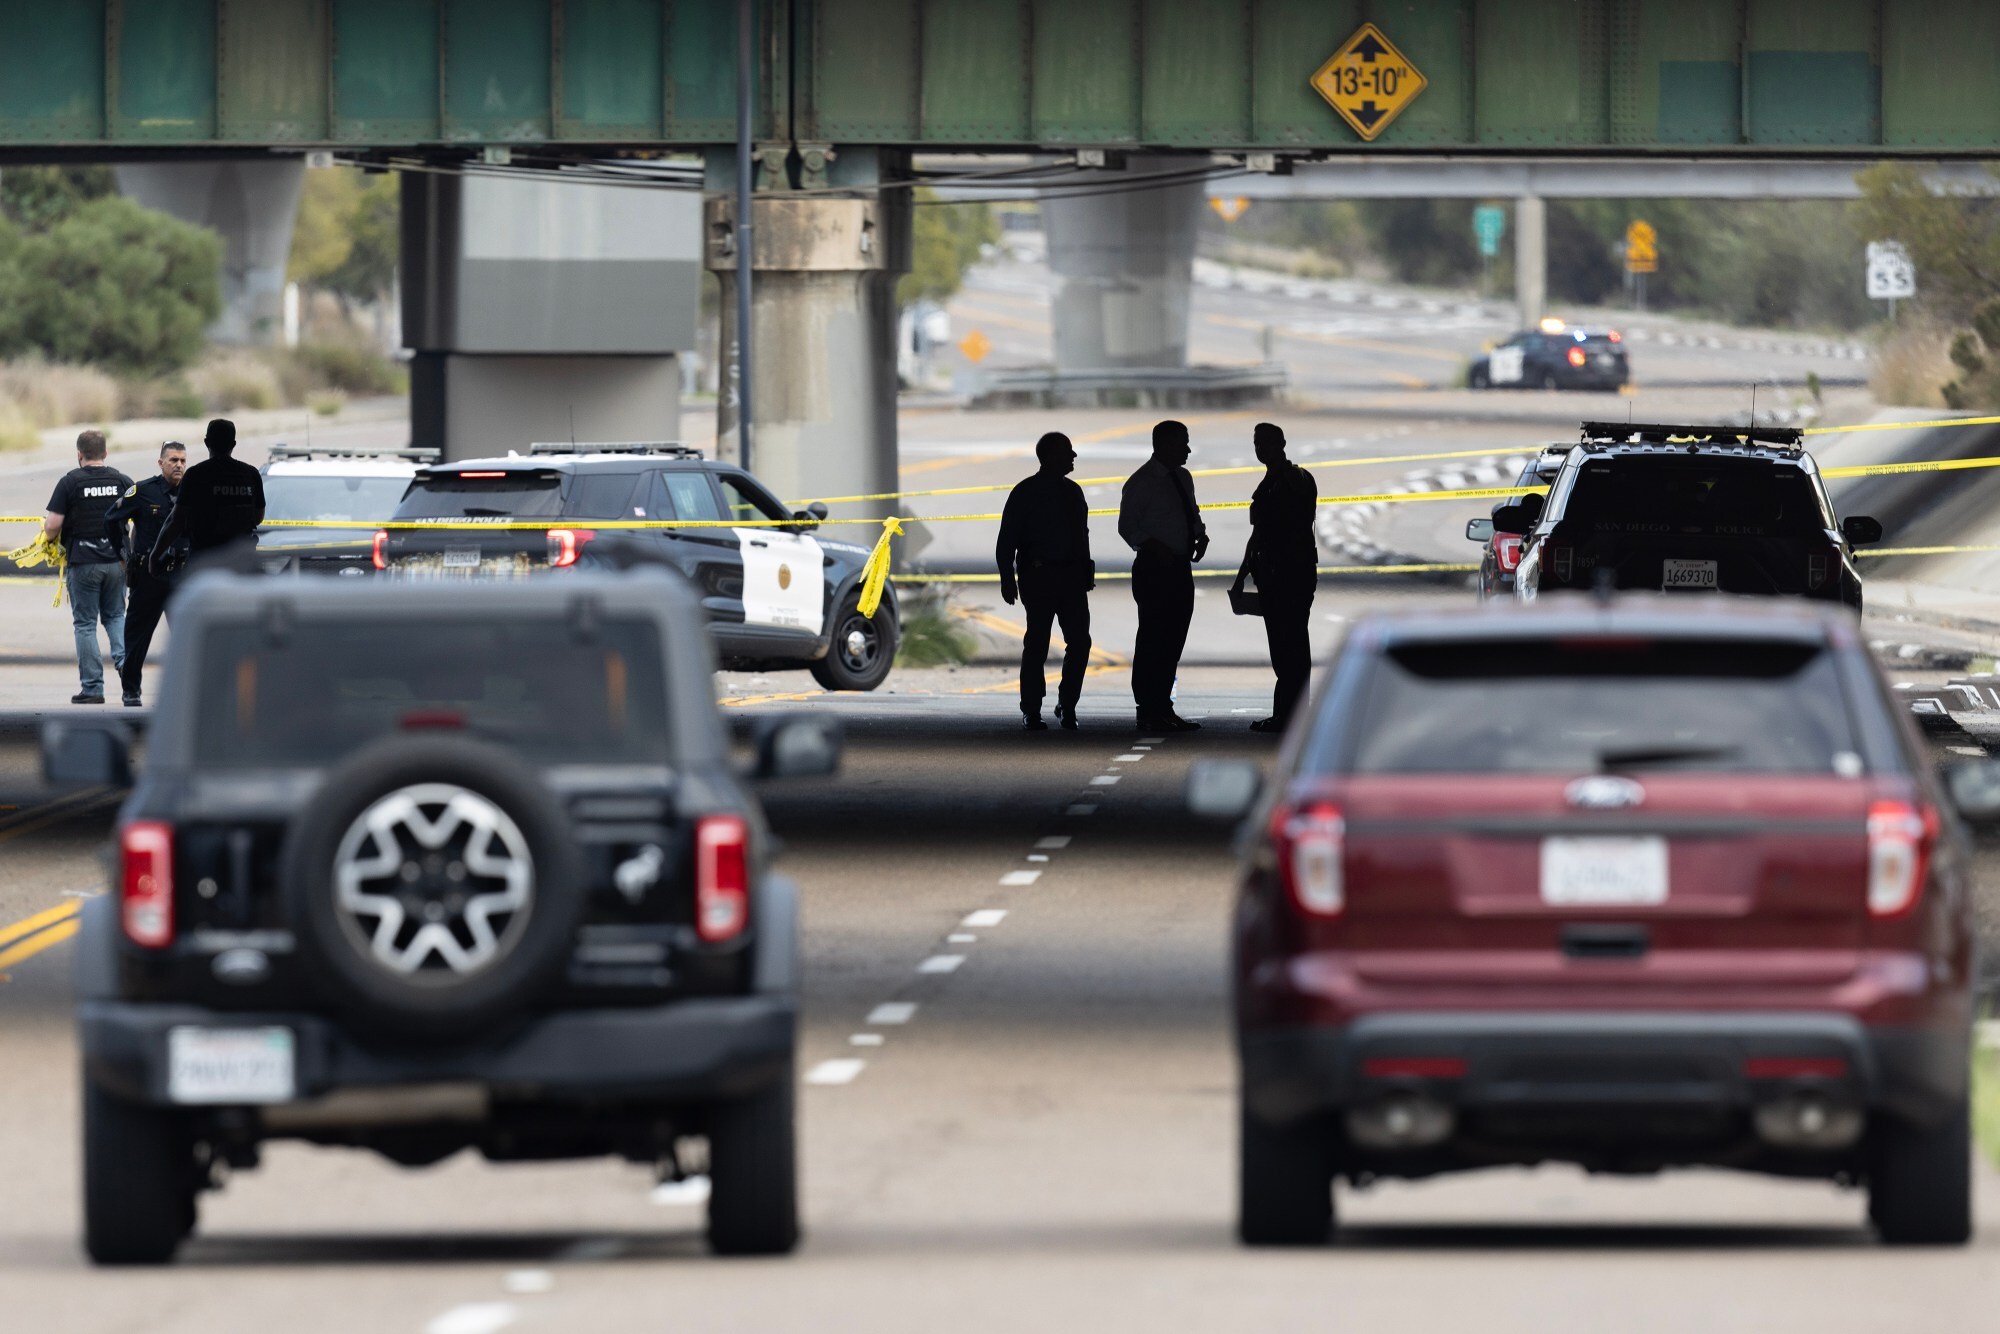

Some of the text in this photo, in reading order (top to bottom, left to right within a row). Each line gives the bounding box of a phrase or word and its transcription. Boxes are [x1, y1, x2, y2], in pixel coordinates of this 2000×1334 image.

[1331, 66, 1408, 96] 13'-10"
[84, 485, 118, 497] POLICE
[212, 485, 253, 496] POLICE
[1594, 521, 1765, 536] SAN DIEGO POLICE
[1666, 569, 1714, 583] 1669370
